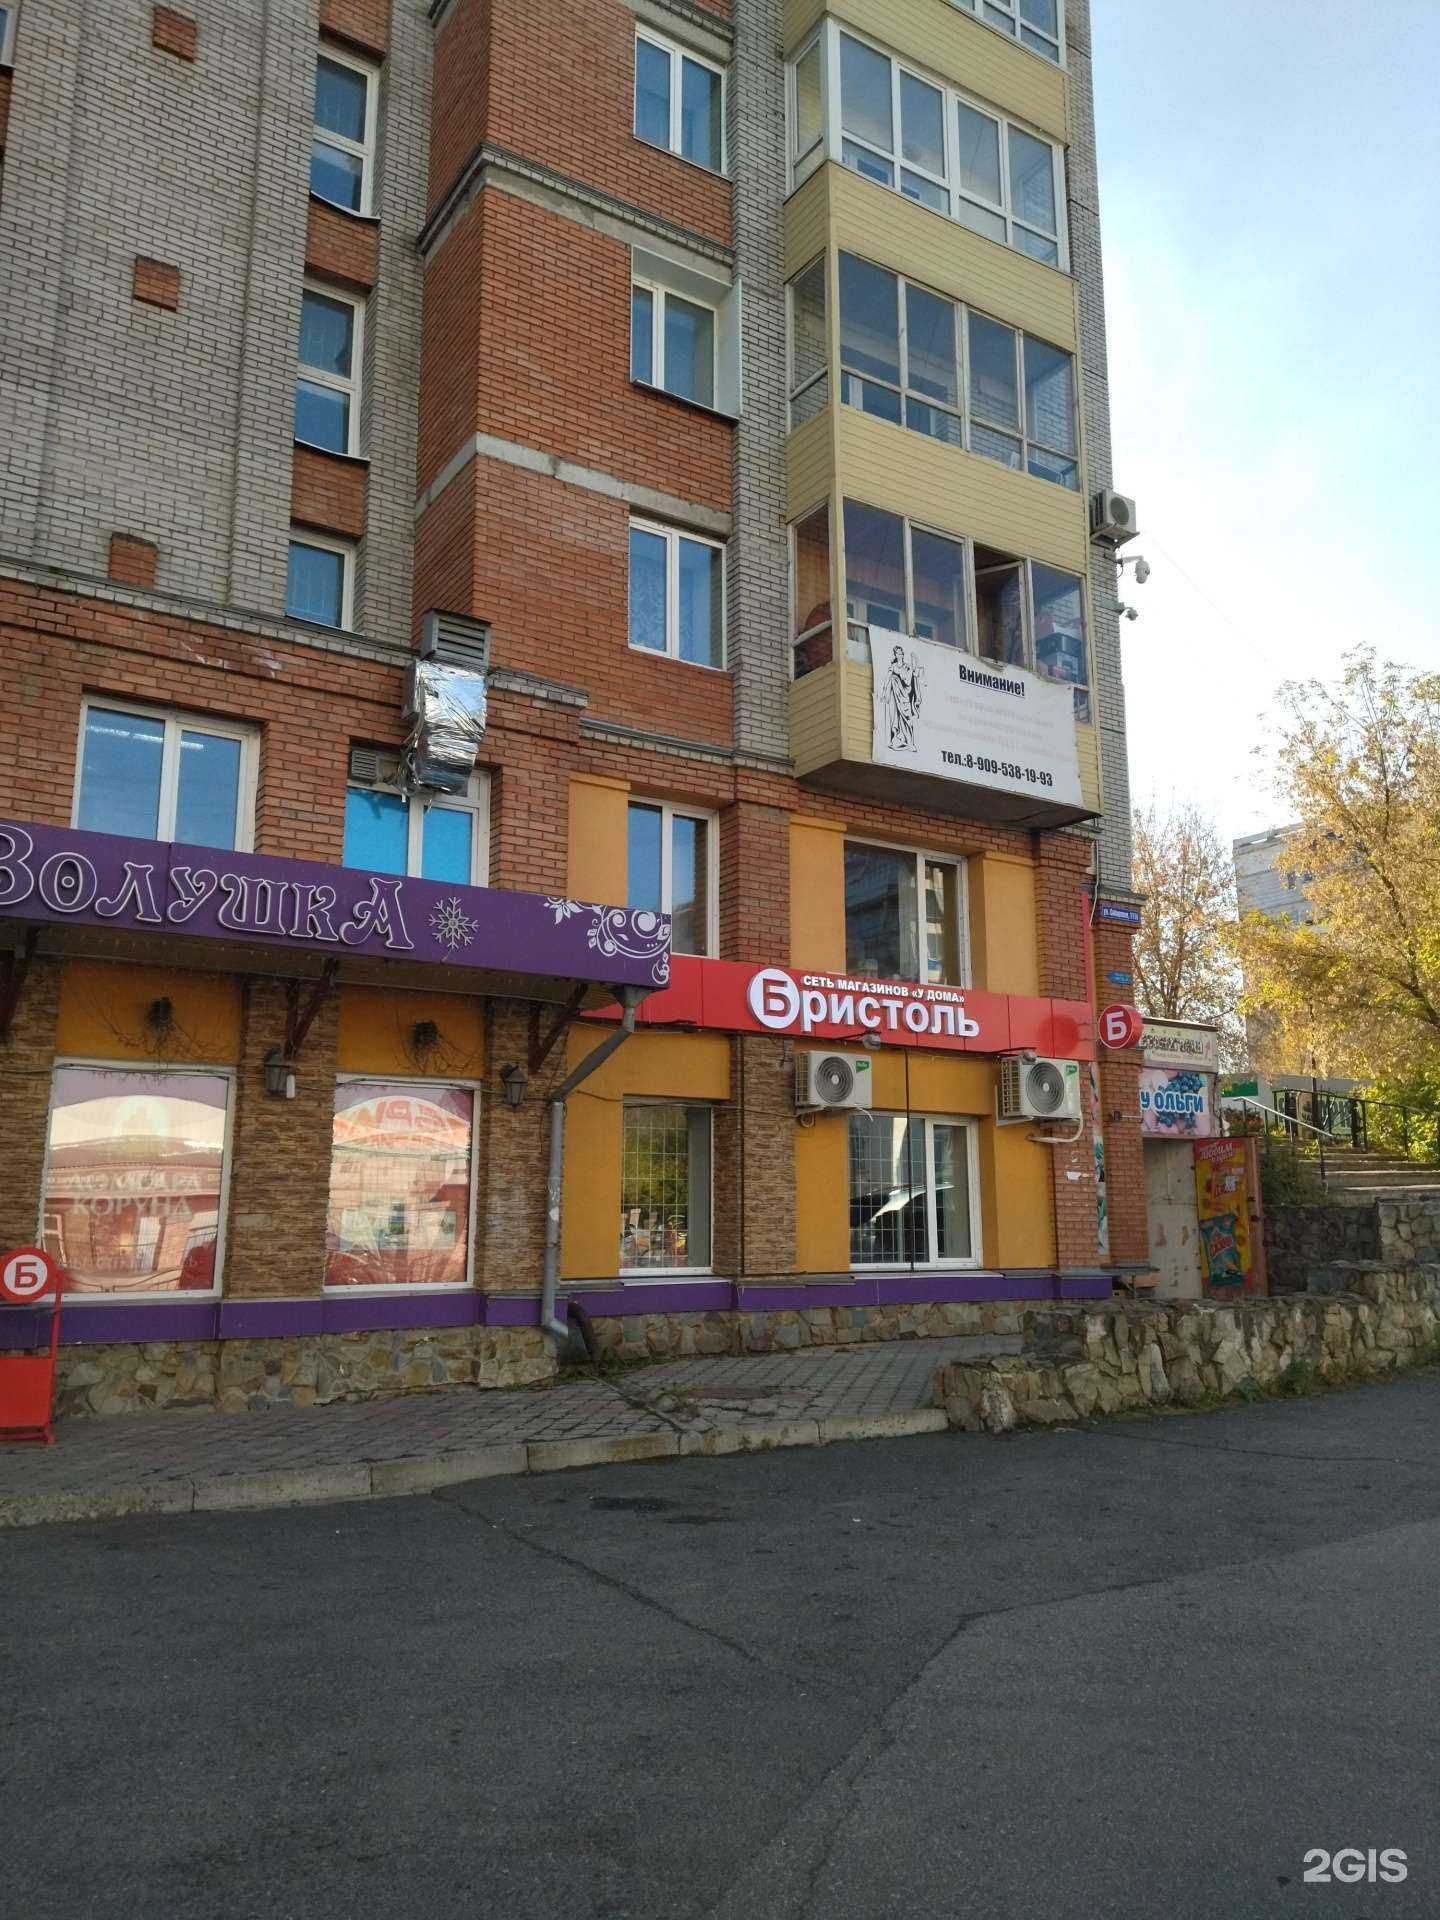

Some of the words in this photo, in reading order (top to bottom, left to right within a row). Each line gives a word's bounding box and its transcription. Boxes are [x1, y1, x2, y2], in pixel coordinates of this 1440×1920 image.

[958, 663, 1026, 698] Внимание!
[940, 750, 1053, 787] тел.:8-909-538-19-93
[803, 975, 835, 989] СЕТЬ
[837, 979, 909, 997] МАГАЗИНОВ
[926, 989, 965, 1003] ДОМА»
[1106, 1011, 1128, 1041] Б
[1140, 1091, 1151, 1109] У
[1154, 1091, 1204, 1113] ОЛЬГИ
[72, 1197, 193, 1221] КОРУНД
[15, 1261, 38, 1288] Б
